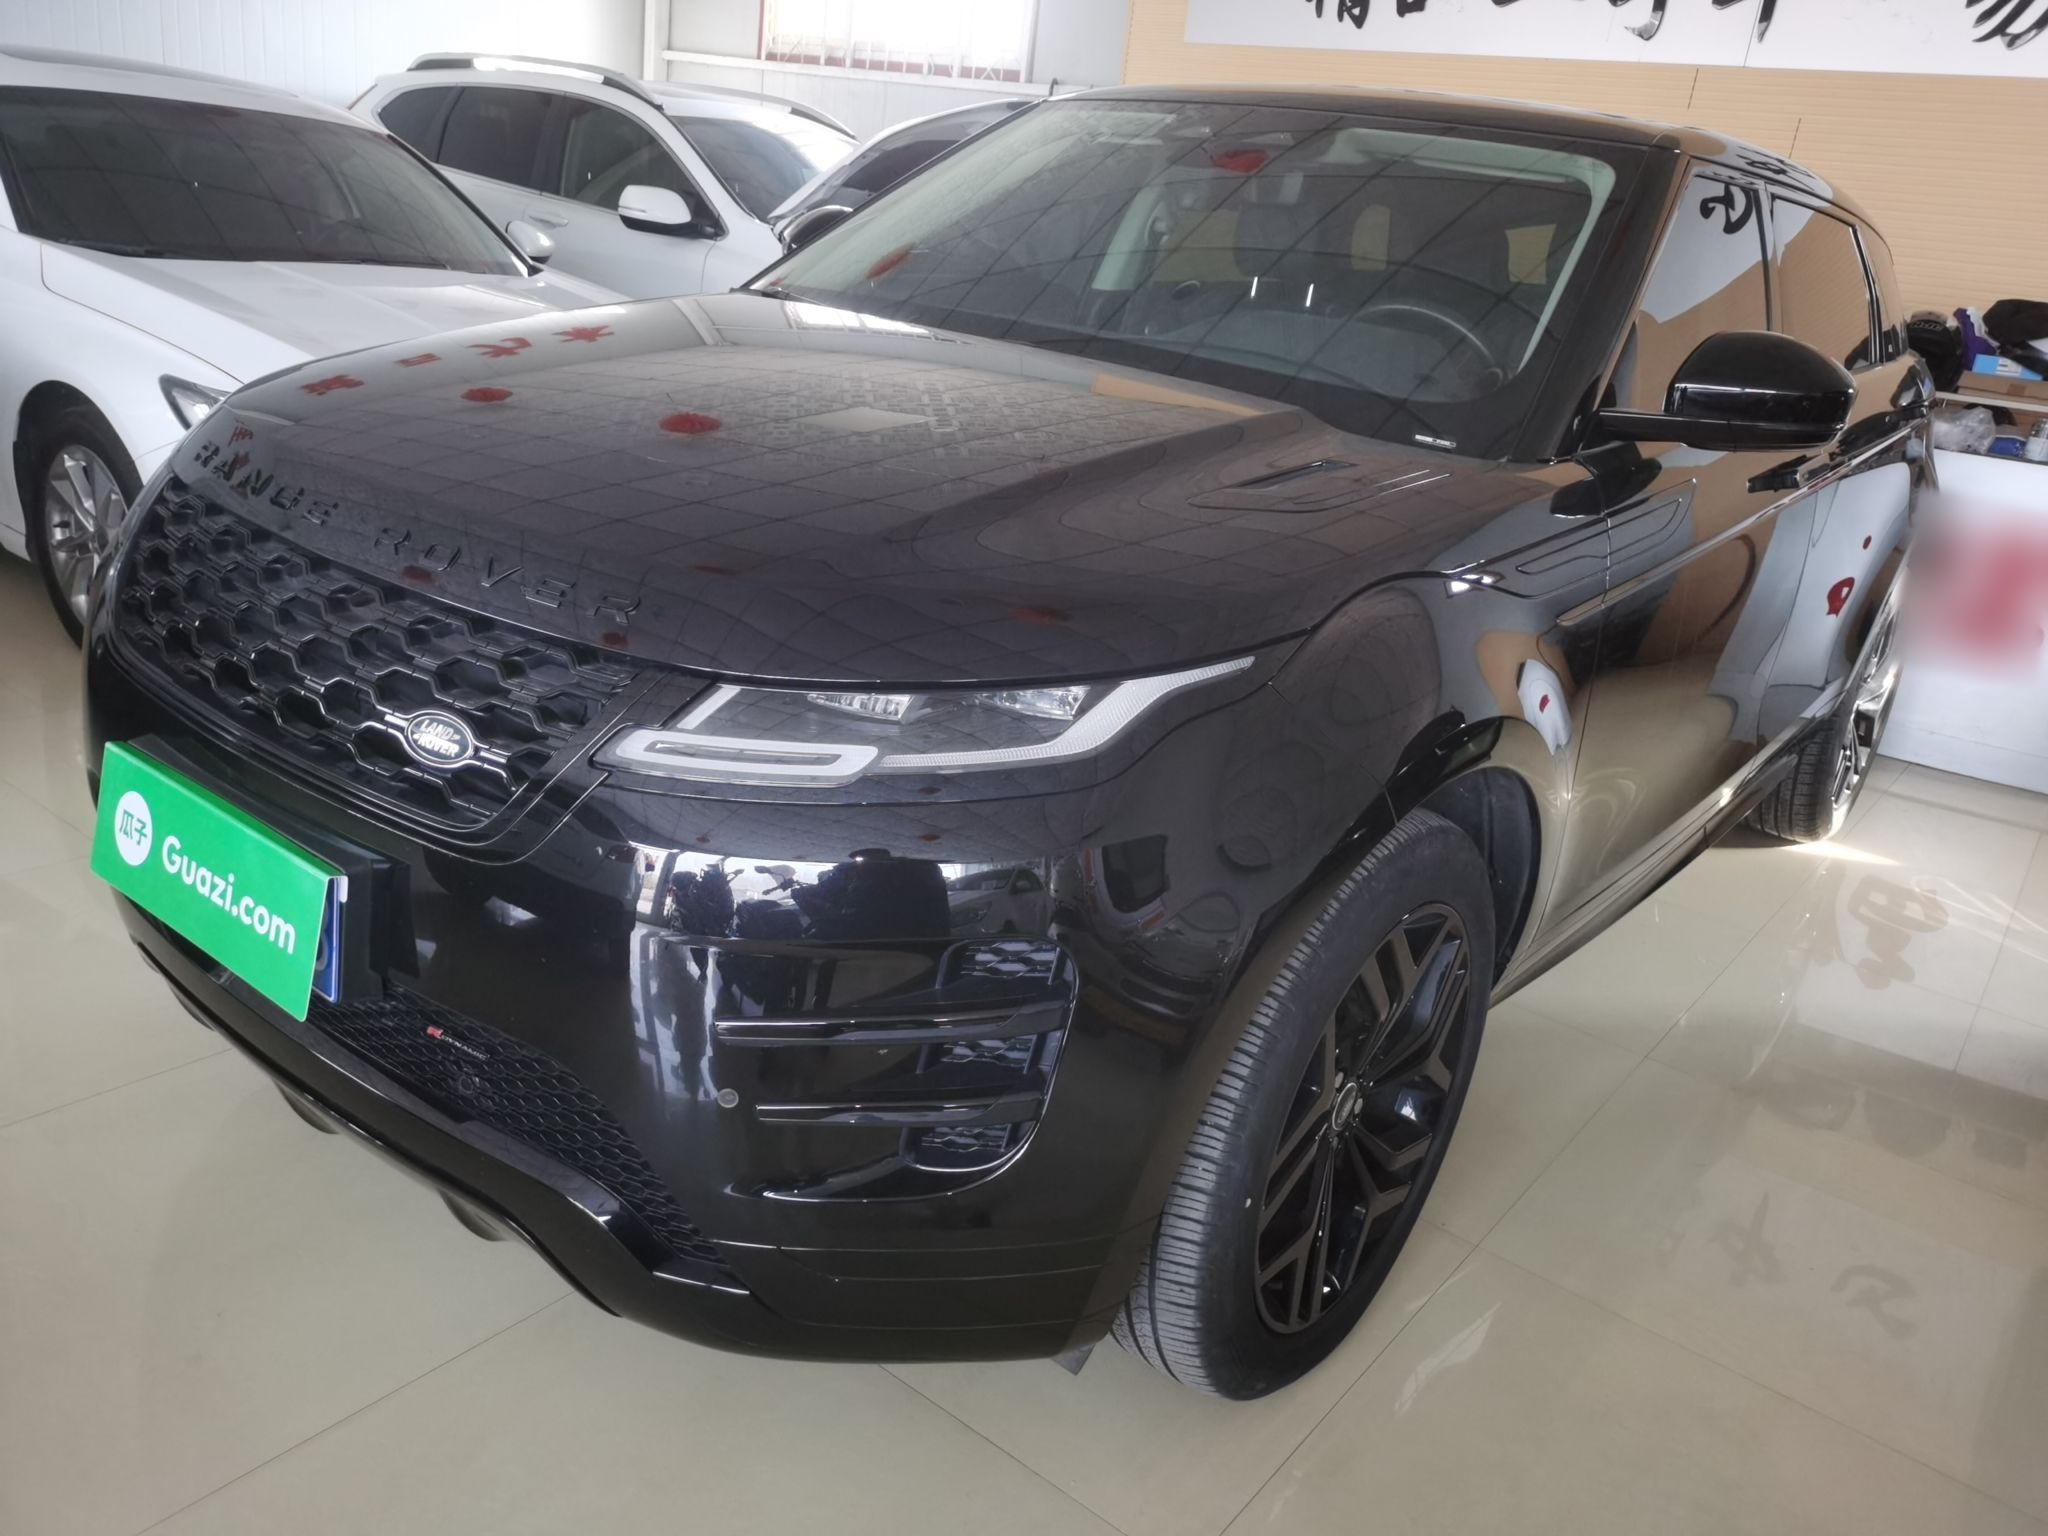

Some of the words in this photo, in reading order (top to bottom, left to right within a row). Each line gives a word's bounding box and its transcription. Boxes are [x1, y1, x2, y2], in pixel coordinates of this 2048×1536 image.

[194, 440, 339, 527] RANGE
[374, 527, 641, 625] ROVER
[418, 733, 460, 758] ROVER
[419, 719, 455, 740] LAND
[119, 809, 148, 846] 瓜子
[162, 835, 296, 955] Guazi.com
